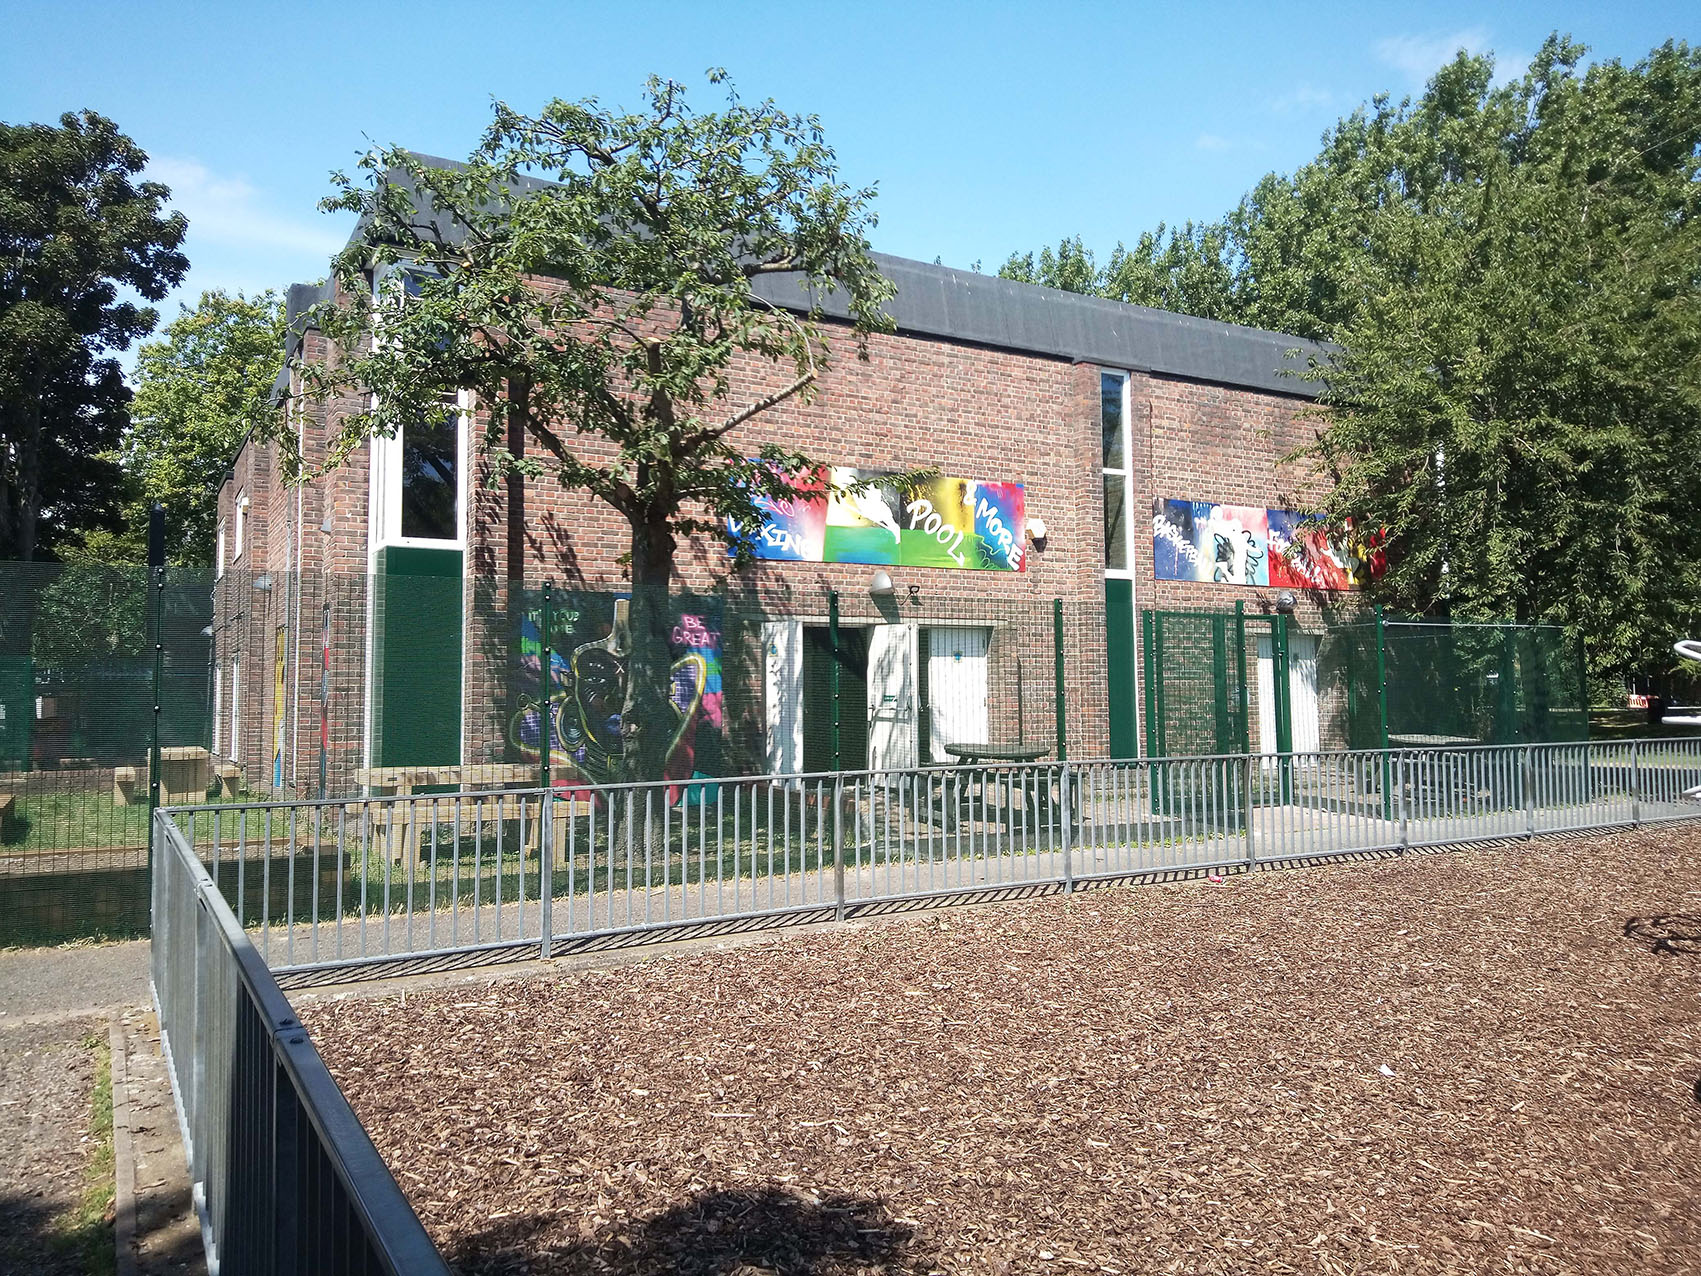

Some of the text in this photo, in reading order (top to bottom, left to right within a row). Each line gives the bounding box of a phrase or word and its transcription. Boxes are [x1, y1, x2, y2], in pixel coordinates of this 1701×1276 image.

[907, 499, 966, 567] POOL
[963, 480, 1024, 571] & MORE
[672, 626, 721, 646] GREAT
[683, 615, 706, 630] BE
